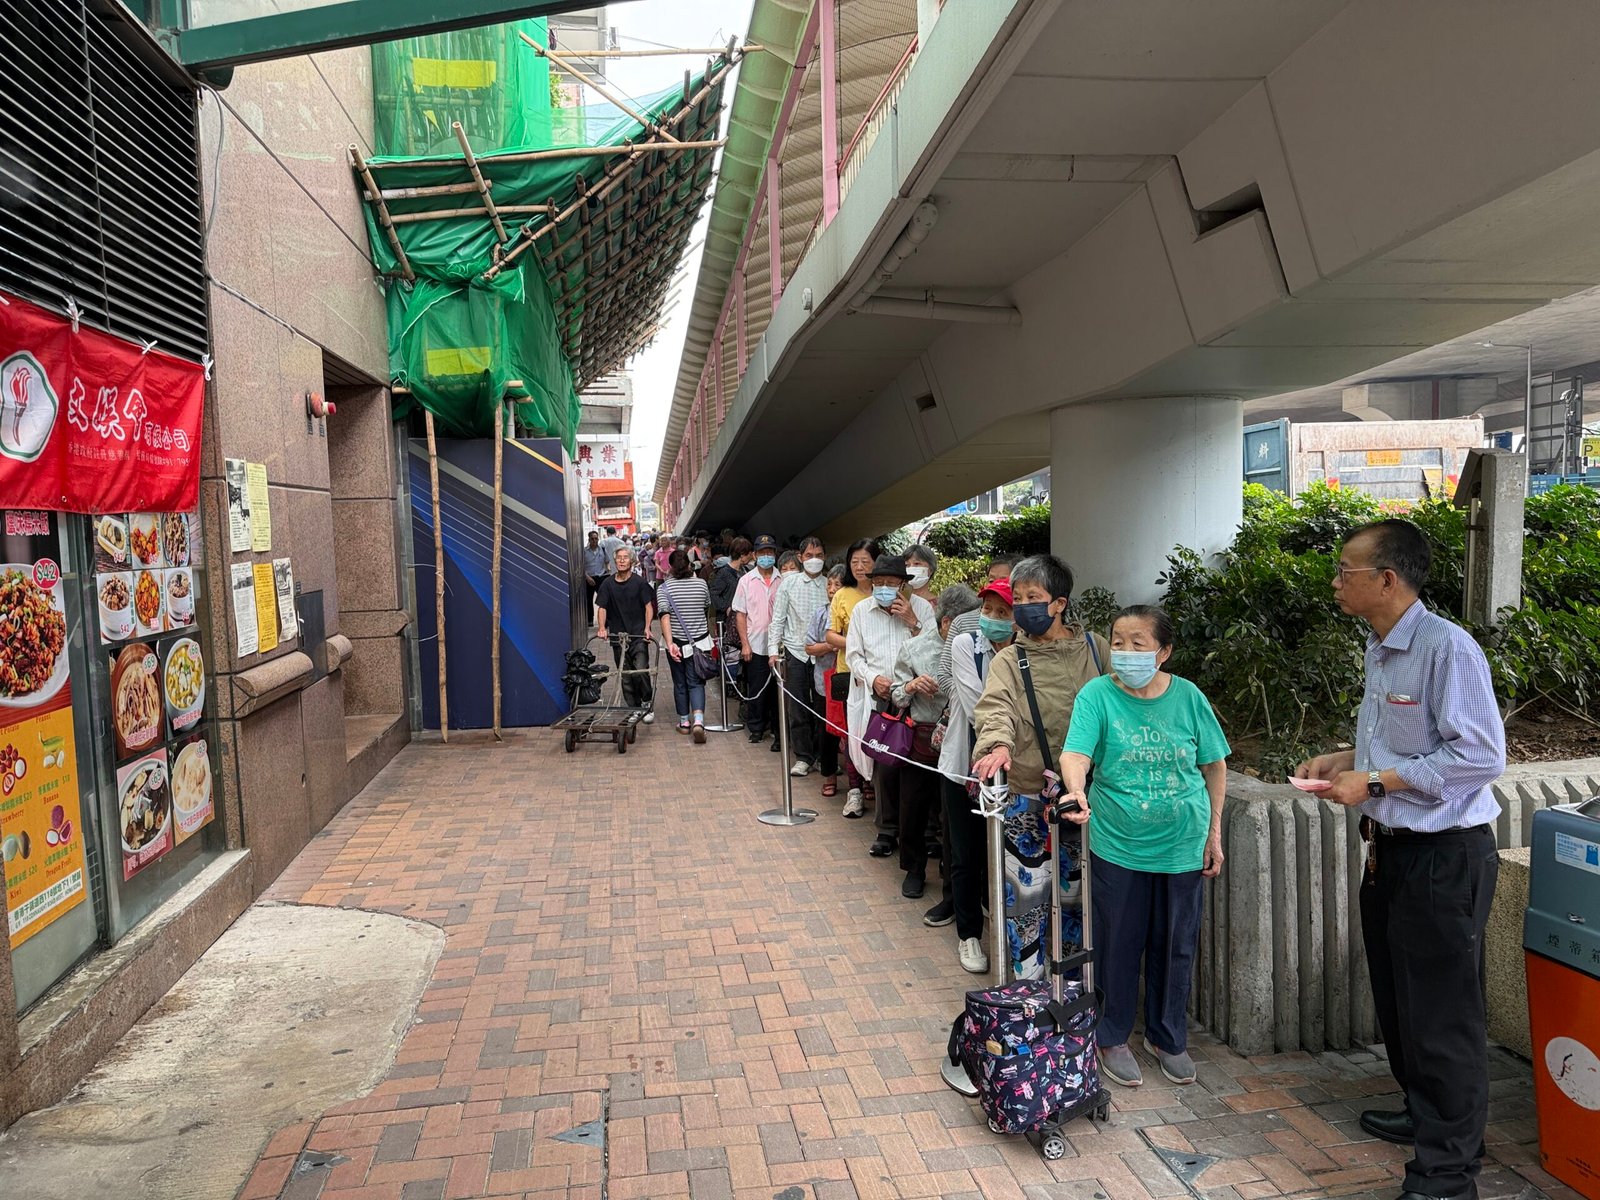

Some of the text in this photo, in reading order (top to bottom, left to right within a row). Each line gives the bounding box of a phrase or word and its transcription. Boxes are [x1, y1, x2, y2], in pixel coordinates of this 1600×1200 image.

[144, 421, 191, 452] 有限公司
[579, 444, 617, 465] 興業
[1584, 445, 1593, 456] P
[36, 562, 56, 584] $42
[120, 623, 130, 635] $42
[1139, 726, 1161, 743] To
[1132, 743, 1178, 762] travel
[1149, 766, 1162, 781] is
[43, 793, 59, 805] Banana
[1148, 785, 1178, 801] live
